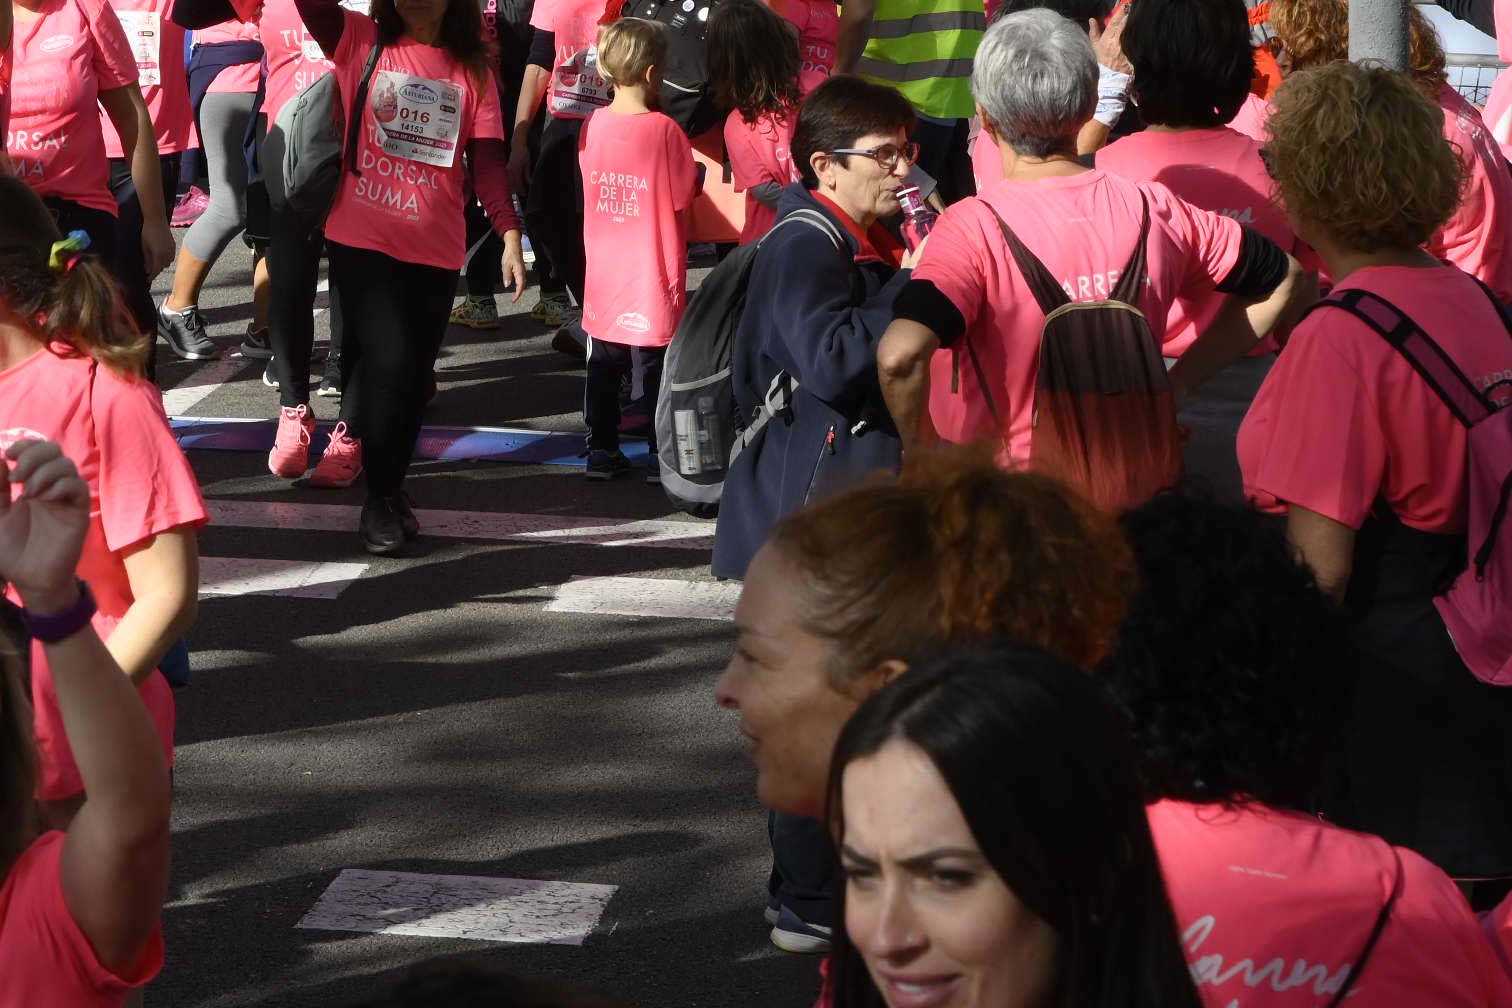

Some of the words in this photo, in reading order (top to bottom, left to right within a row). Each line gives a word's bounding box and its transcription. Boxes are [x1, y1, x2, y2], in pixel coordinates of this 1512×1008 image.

[807, 45, 829, 59] TU
[399, 108, 430, 123] 016
[400, 121, 425, 134] 14153
[590, 171, 648, 191] CARRERA
[355, 176, 419, 213] SUMA
[600, 186, 617, 200] DE
[623, 189, 638, 202] LA
[596, 200, 640, 217] MUJER
[1062, 270, 1120, 300] ARRE
